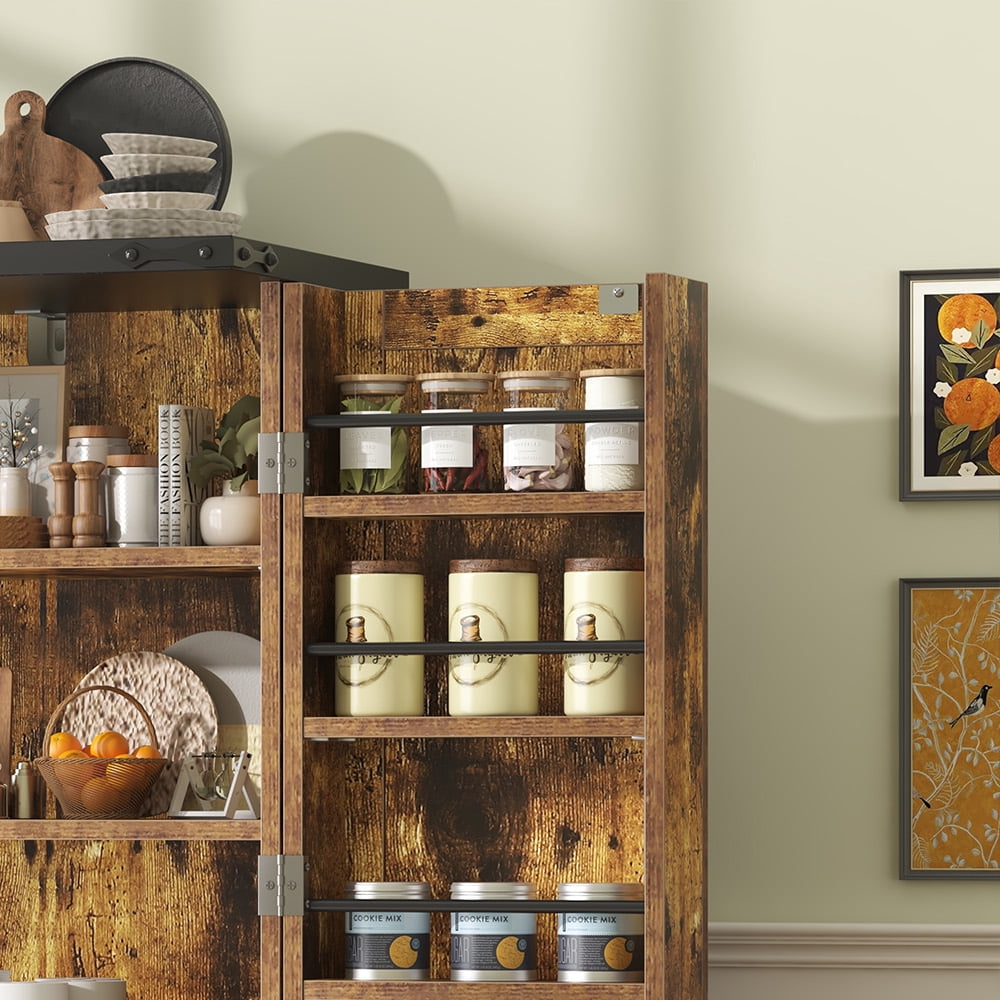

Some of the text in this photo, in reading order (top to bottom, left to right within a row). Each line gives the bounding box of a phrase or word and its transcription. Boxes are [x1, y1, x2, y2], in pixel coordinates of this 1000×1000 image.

[160, 409, 169, 449] BOOK
[172, 409, 180, 449] BOOK
[160, 454, 169, 515] FASHION
[172, 454, 180, 515] FASHION
[353, 914, 383, 922] COOKIE
[459, 915, 509, 923] COOKIE MIX
[567, 916, 598, 924] COOKIE
